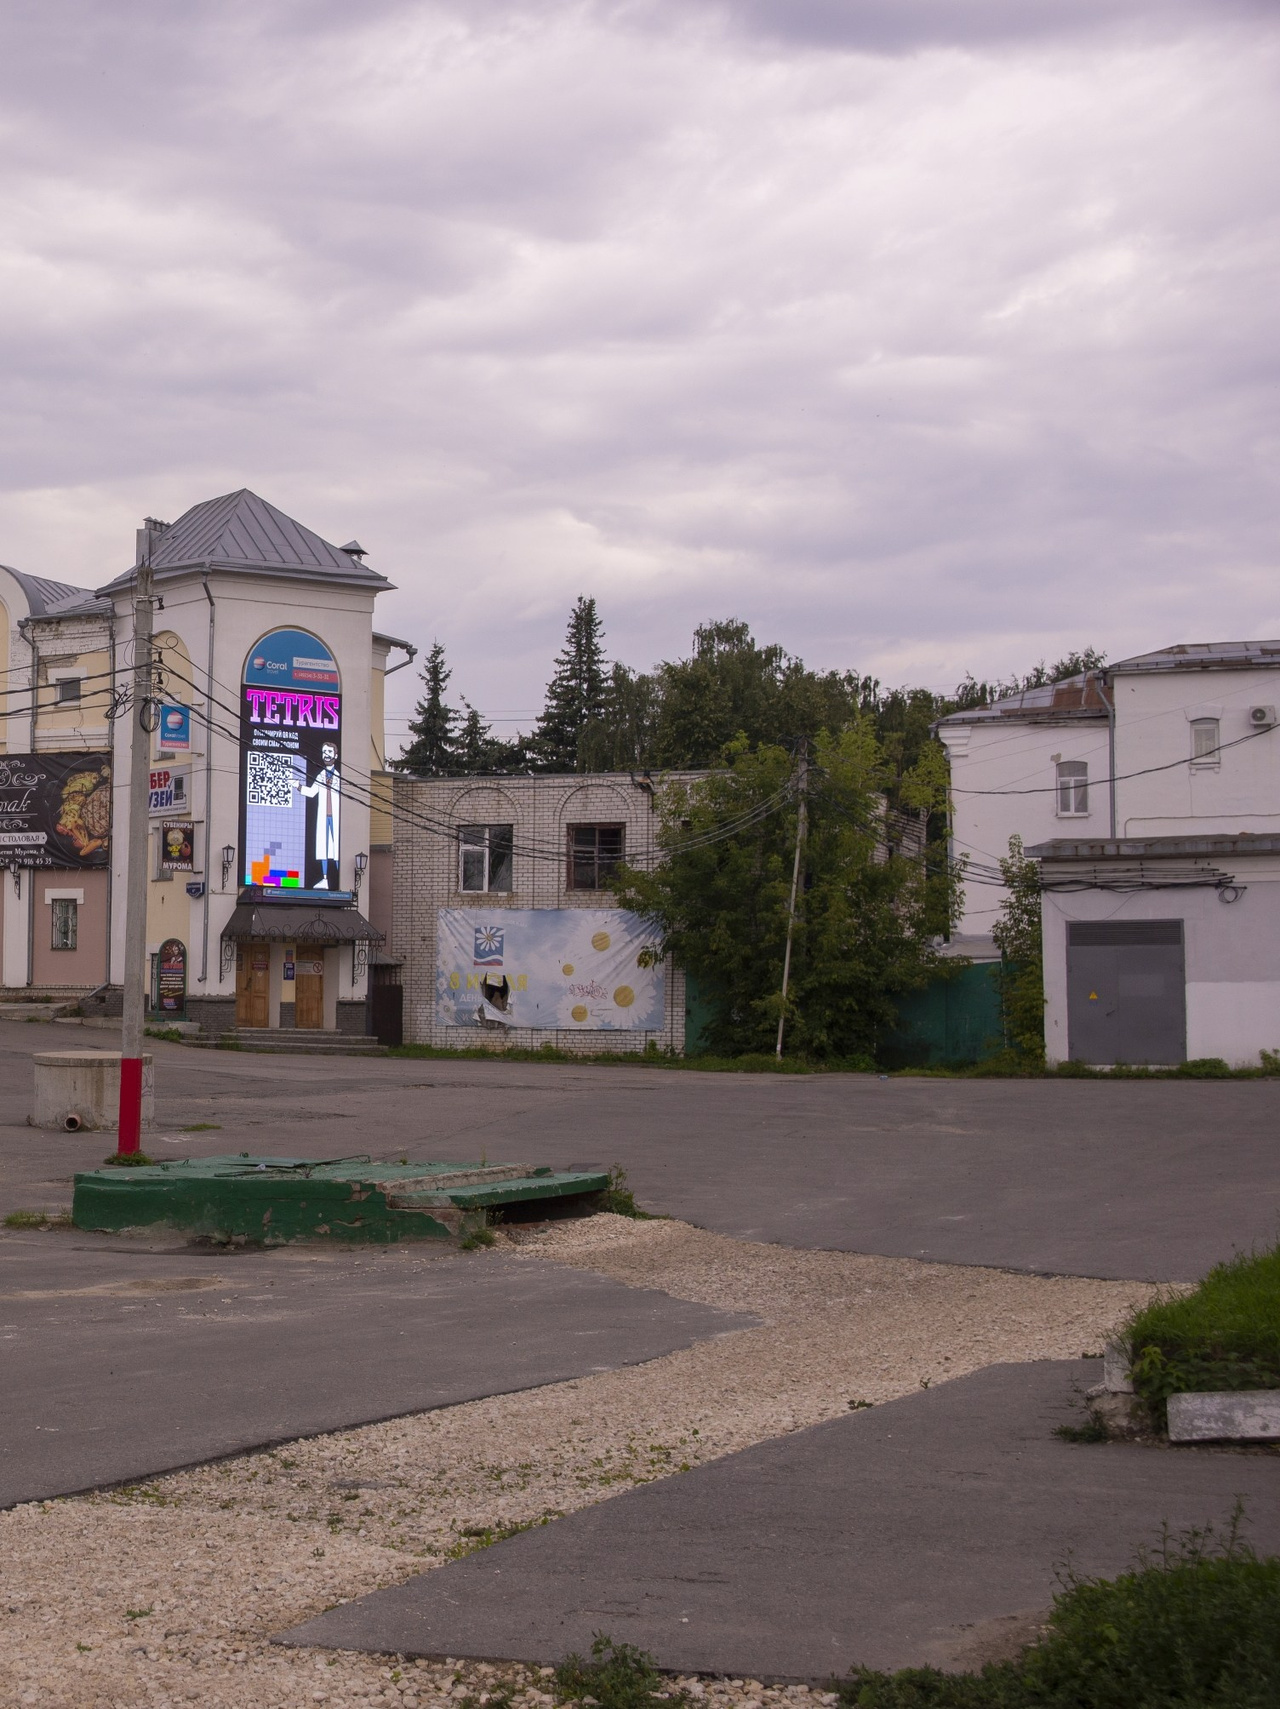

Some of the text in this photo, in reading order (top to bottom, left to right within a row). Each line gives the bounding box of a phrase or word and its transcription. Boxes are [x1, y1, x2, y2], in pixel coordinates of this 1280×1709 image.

[266, 661, 288, 671] Coral
[296, 659, 329, 669] Турагентство
[247, 688, 339, 730] TETRIS
[149, 771, 170, 790] БЕР
[149, 784, 173, 808] УЗЕЙ
[163, 821, 193, 829] СУВЕНИРЫ
[2, 835, 40, 843] СТОЛОВАЯ
[35, 857, 43, 865] 45
[45, 857, 52, 865] 35
[162, 861, 193, 870] МУРОМА
[449, 972, 460, 990] 8
